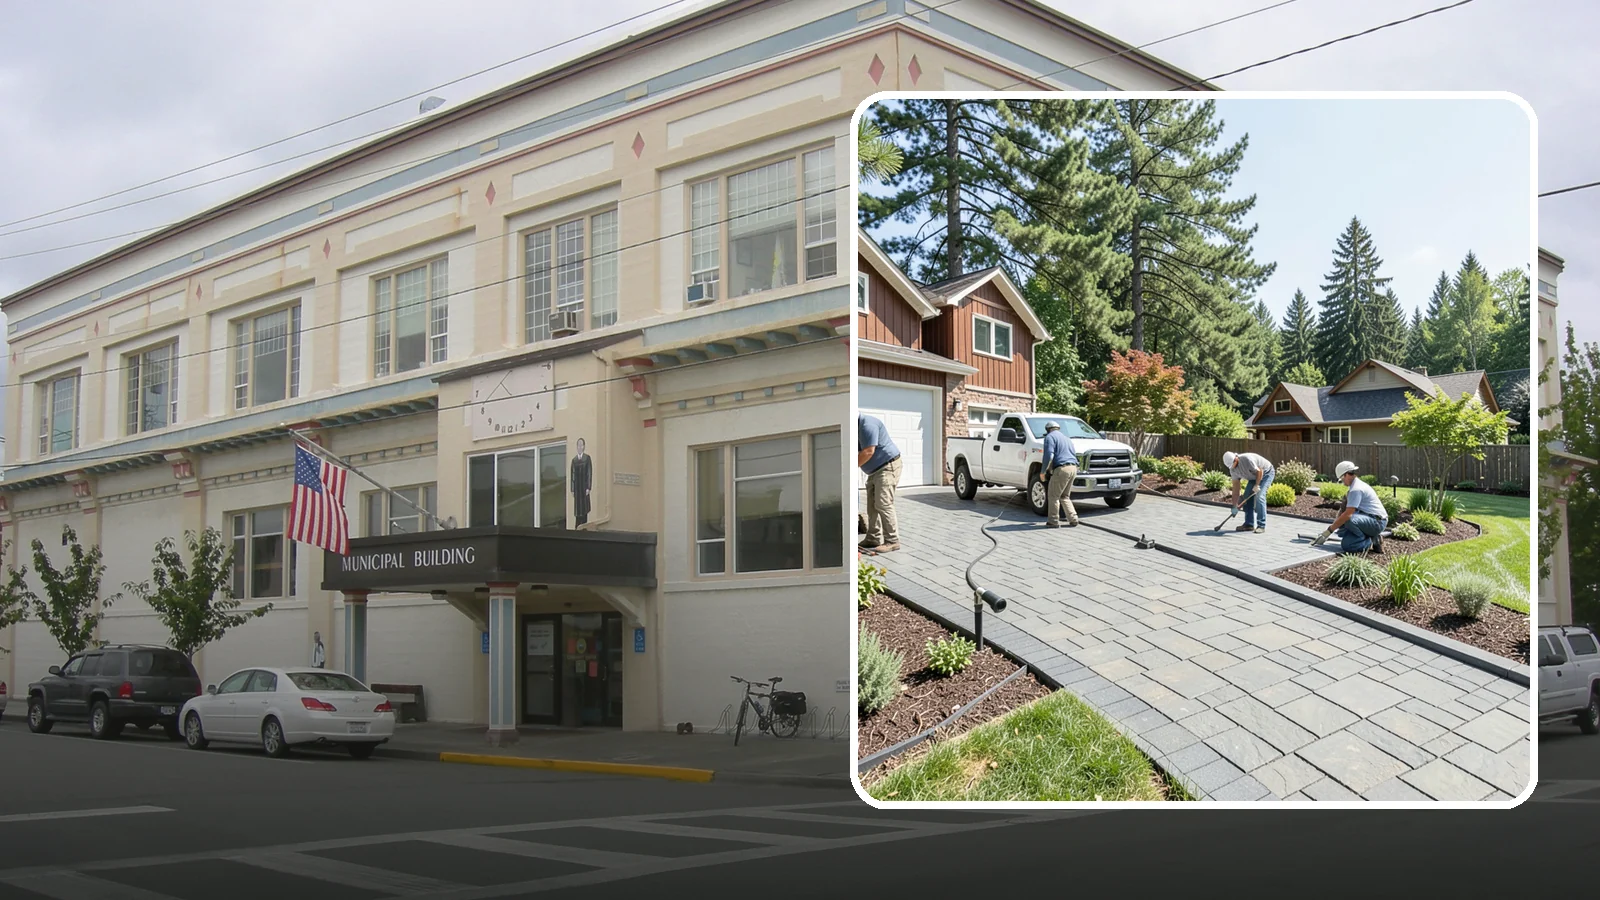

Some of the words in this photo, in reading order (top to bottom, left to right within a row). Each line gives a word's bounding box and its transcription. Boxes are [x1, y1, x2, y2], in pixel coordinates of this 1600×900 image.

[481, 406, 485, 415] 8
[487, 417, 493, 426] 9
[494, 423, 500, 432] 10
[507, 425, 513, 433] 12
[521, 420, 526, 428] 2
[529, 413, 533, 422] 3
[536, 402, 540, 410] 4
[342, 552, 405, 572] MUNICIPAL
[414, 546, 475, 567] BUILDING
